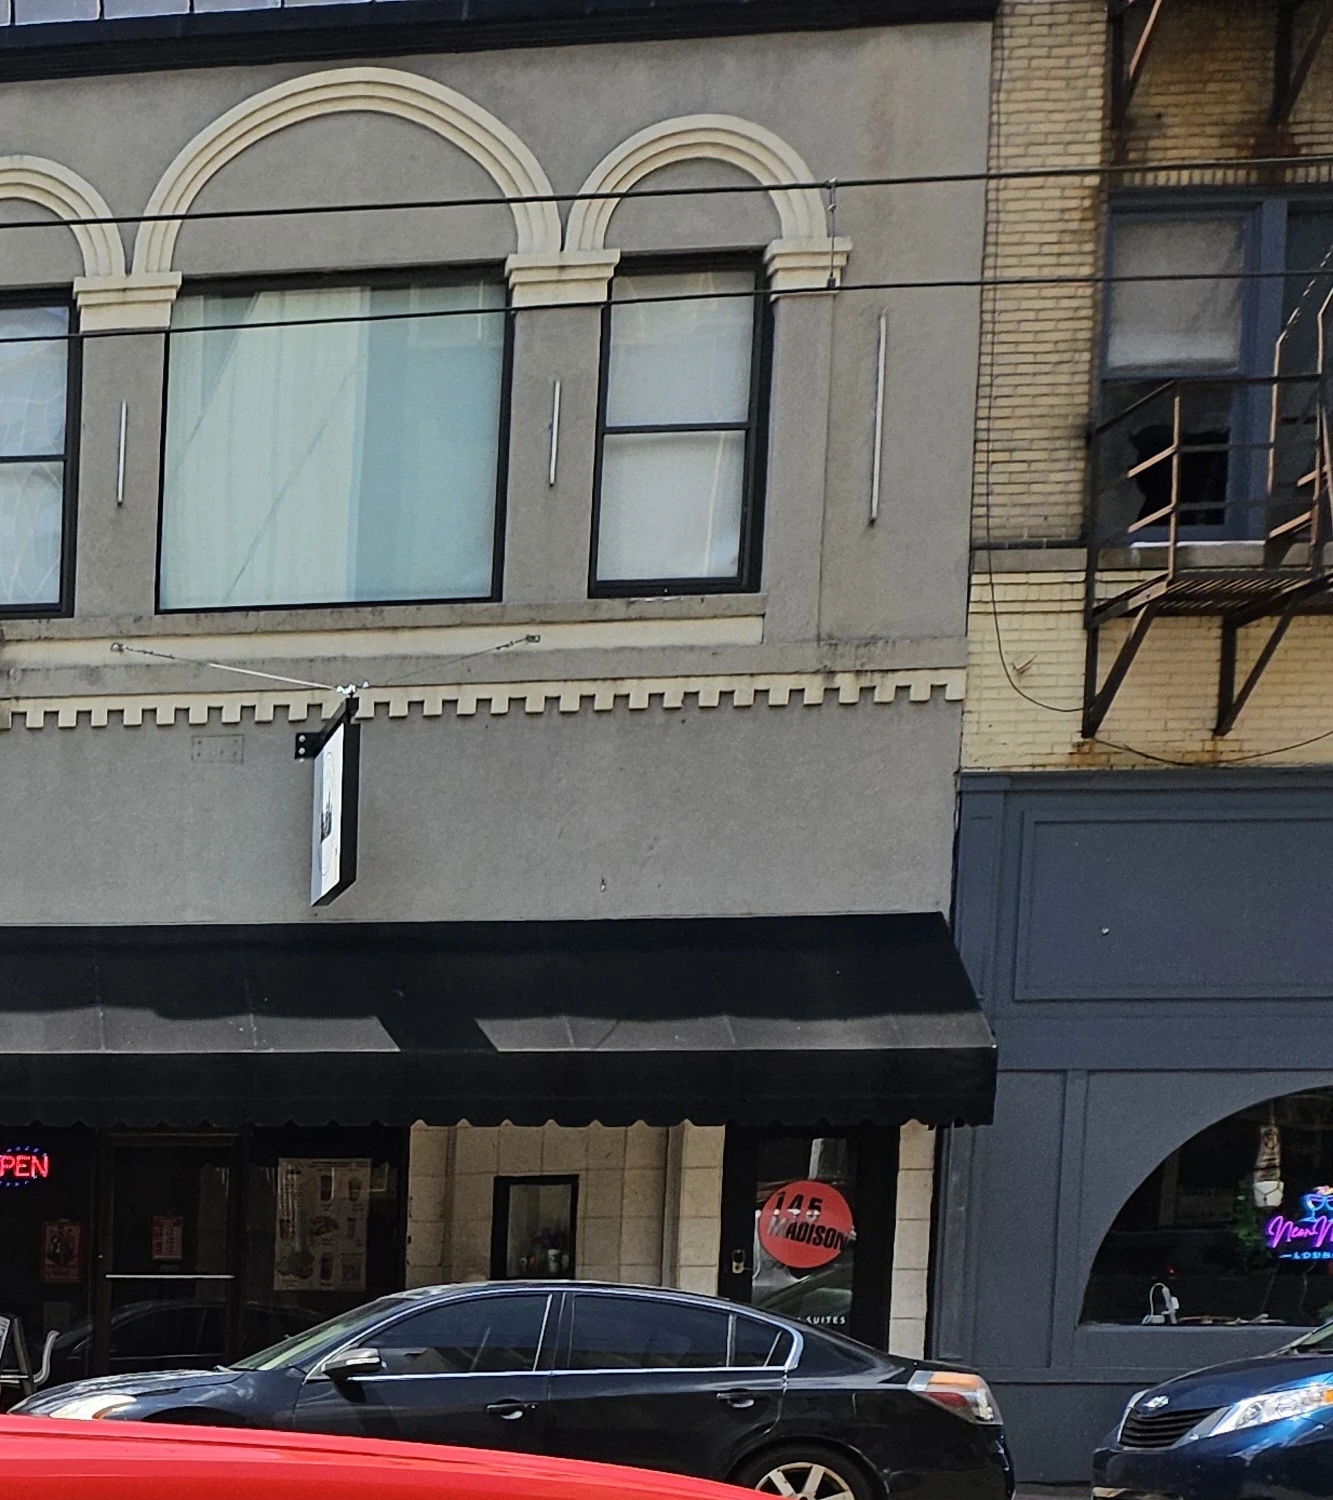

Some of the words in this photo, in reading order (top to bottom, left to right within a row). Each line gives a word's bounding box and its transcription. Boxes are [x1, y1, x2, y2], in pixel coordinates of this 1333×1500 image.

[773, 1191, 823, 1222] 145
[767, 1214, 849, 1250] MADISON
[1268, 1215, 1317, 1249] Neon
[1293, 1251, 1333, 1259] LOUN
